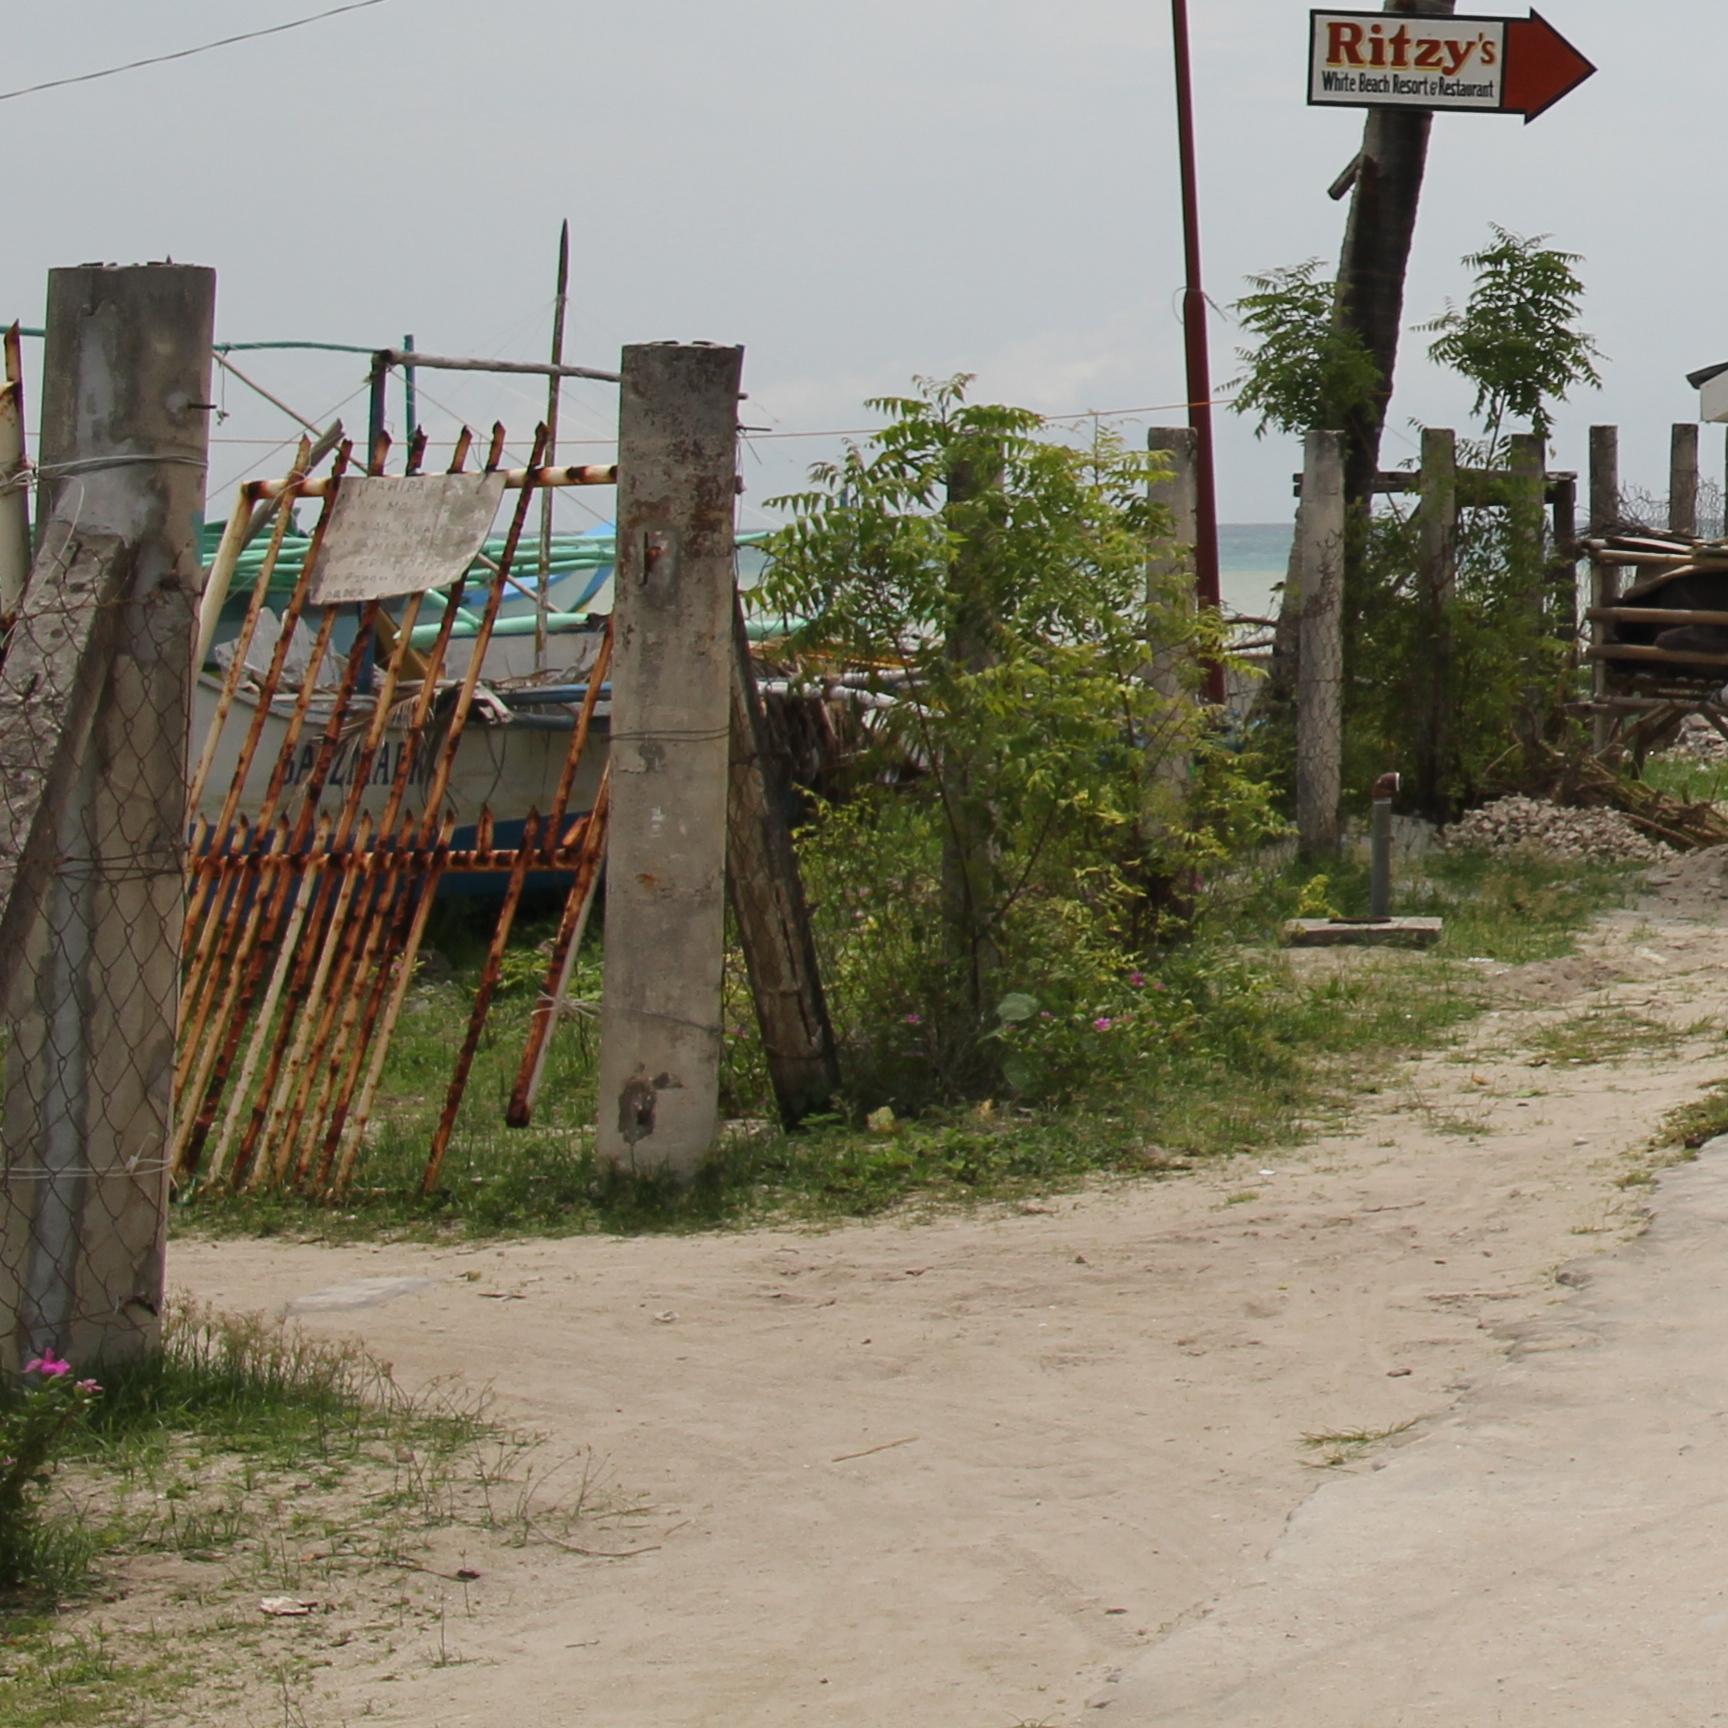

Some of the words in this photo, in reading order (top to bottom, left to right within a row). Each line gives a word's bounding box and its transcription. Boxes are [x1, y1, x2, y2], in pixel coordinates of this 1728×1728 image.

[1326, 21, 1496, 76] Ritzy's
[1322, 70, 1356, 93] White
[1359, 73, 1390, 95] Beach
[1392, 74, 1429, 96] Resort
[1438, 76, 1494, 99] Restaurant
